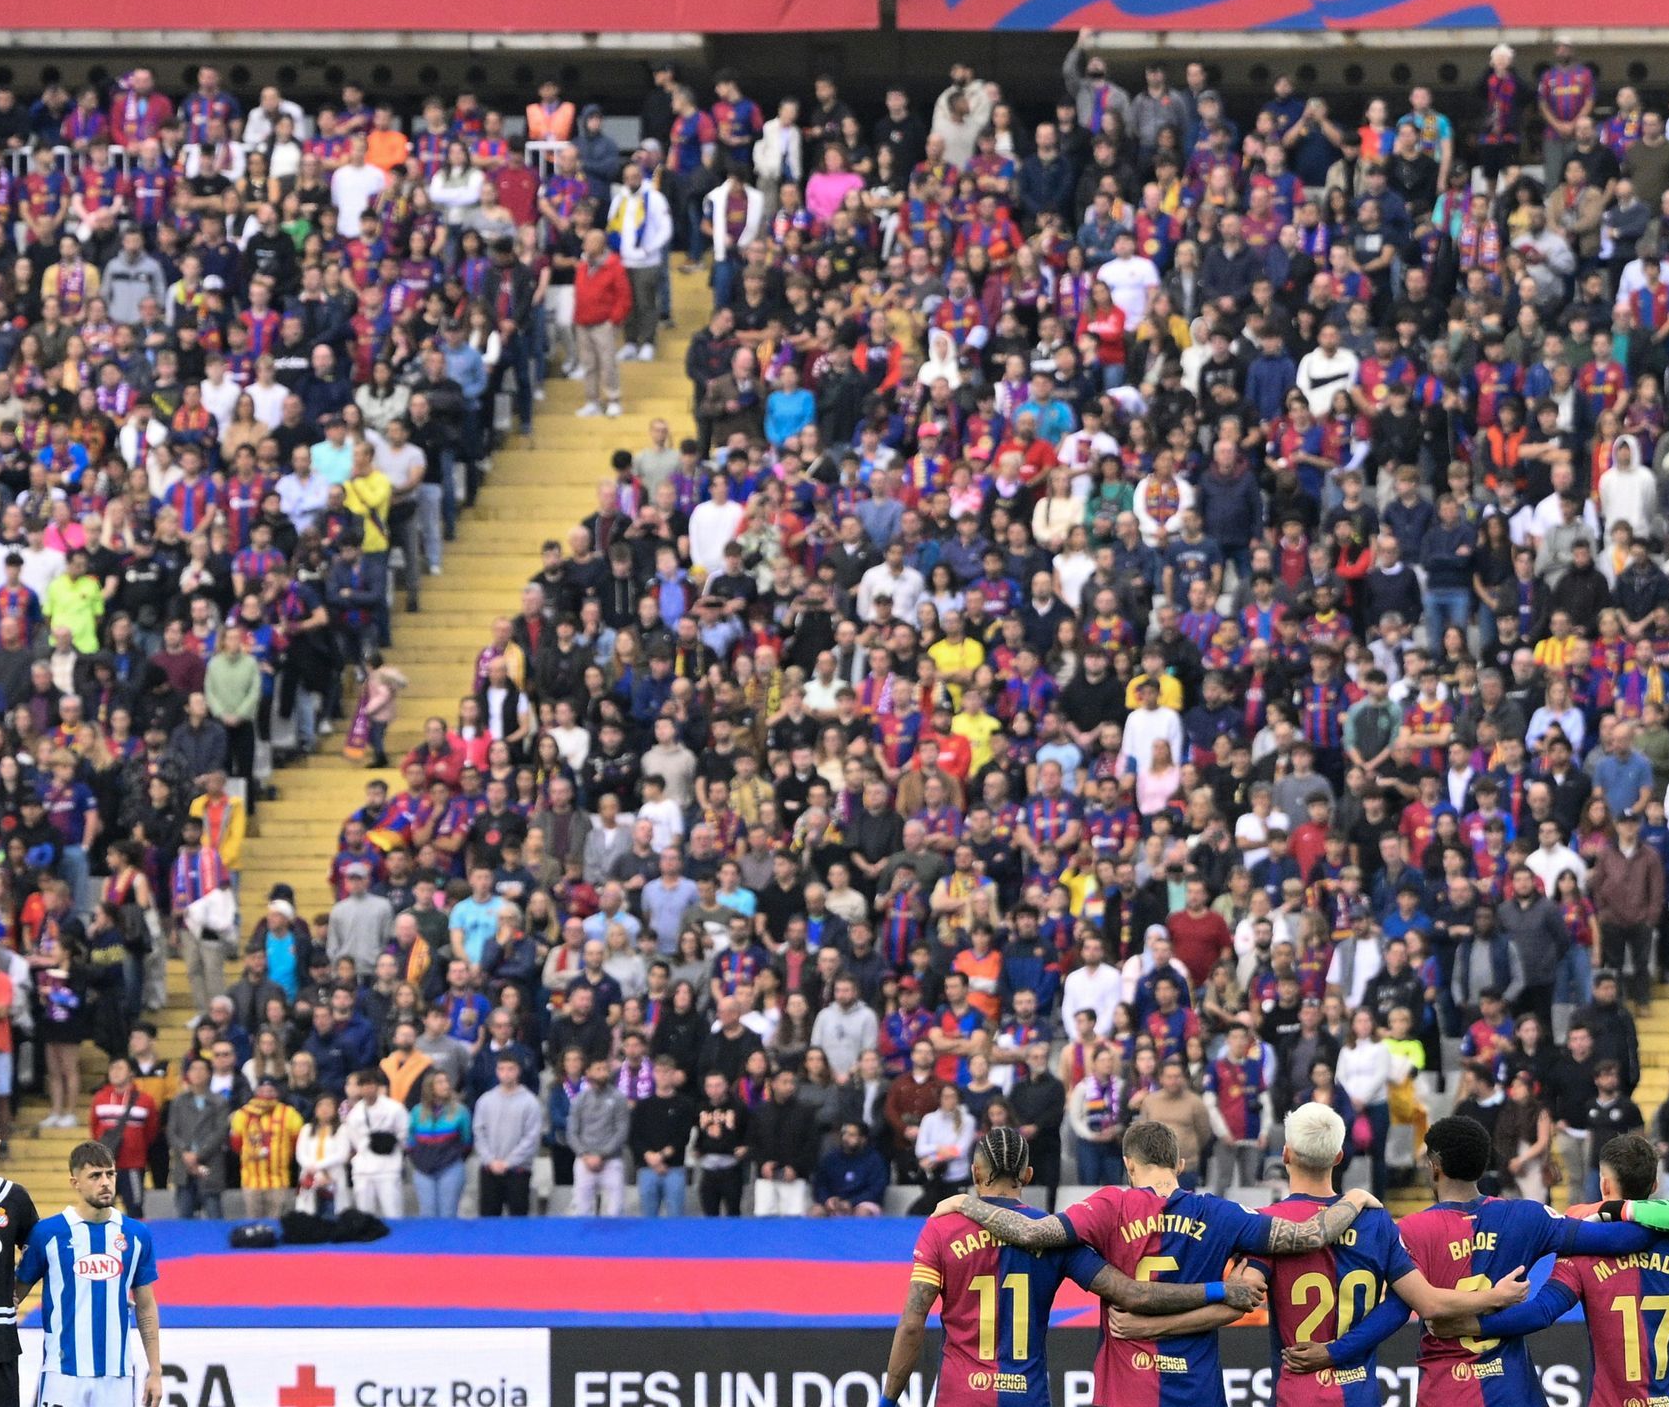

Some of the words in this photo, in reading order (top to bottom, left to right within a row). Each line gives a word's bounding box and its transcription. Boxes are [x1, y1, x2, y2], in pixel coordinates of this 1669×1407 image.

[79, 1260, 114, 1276] DANI
[968, 1273, 1029, 1360] 11
[1290, 1268, 1378, 1344] 20
[355, 1380, 437, 1407] Cruz
[451, 1377, 527, 1407] Roja
